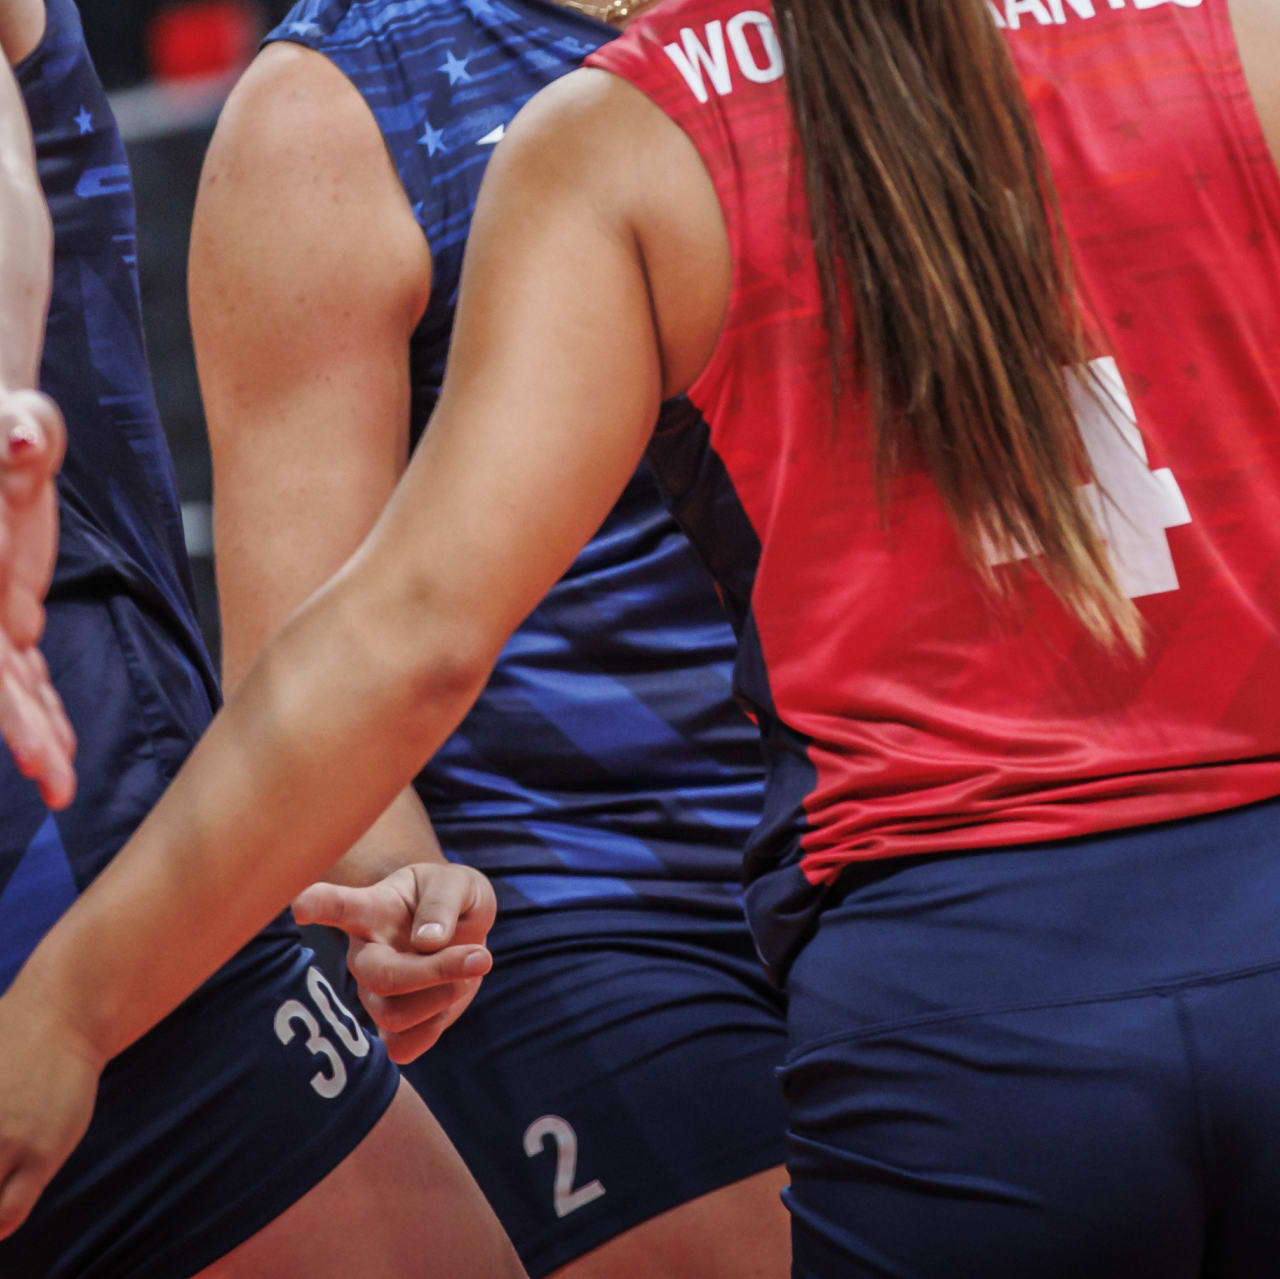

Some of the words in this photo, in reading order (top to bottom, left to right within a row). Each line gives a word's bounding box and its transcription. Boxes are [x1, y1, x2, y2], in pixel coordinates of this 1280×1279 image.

[663, 9, 785, 104] WO
[273, 965, 371, 1100] 30
[522, 1114, 607, 1219] 2
